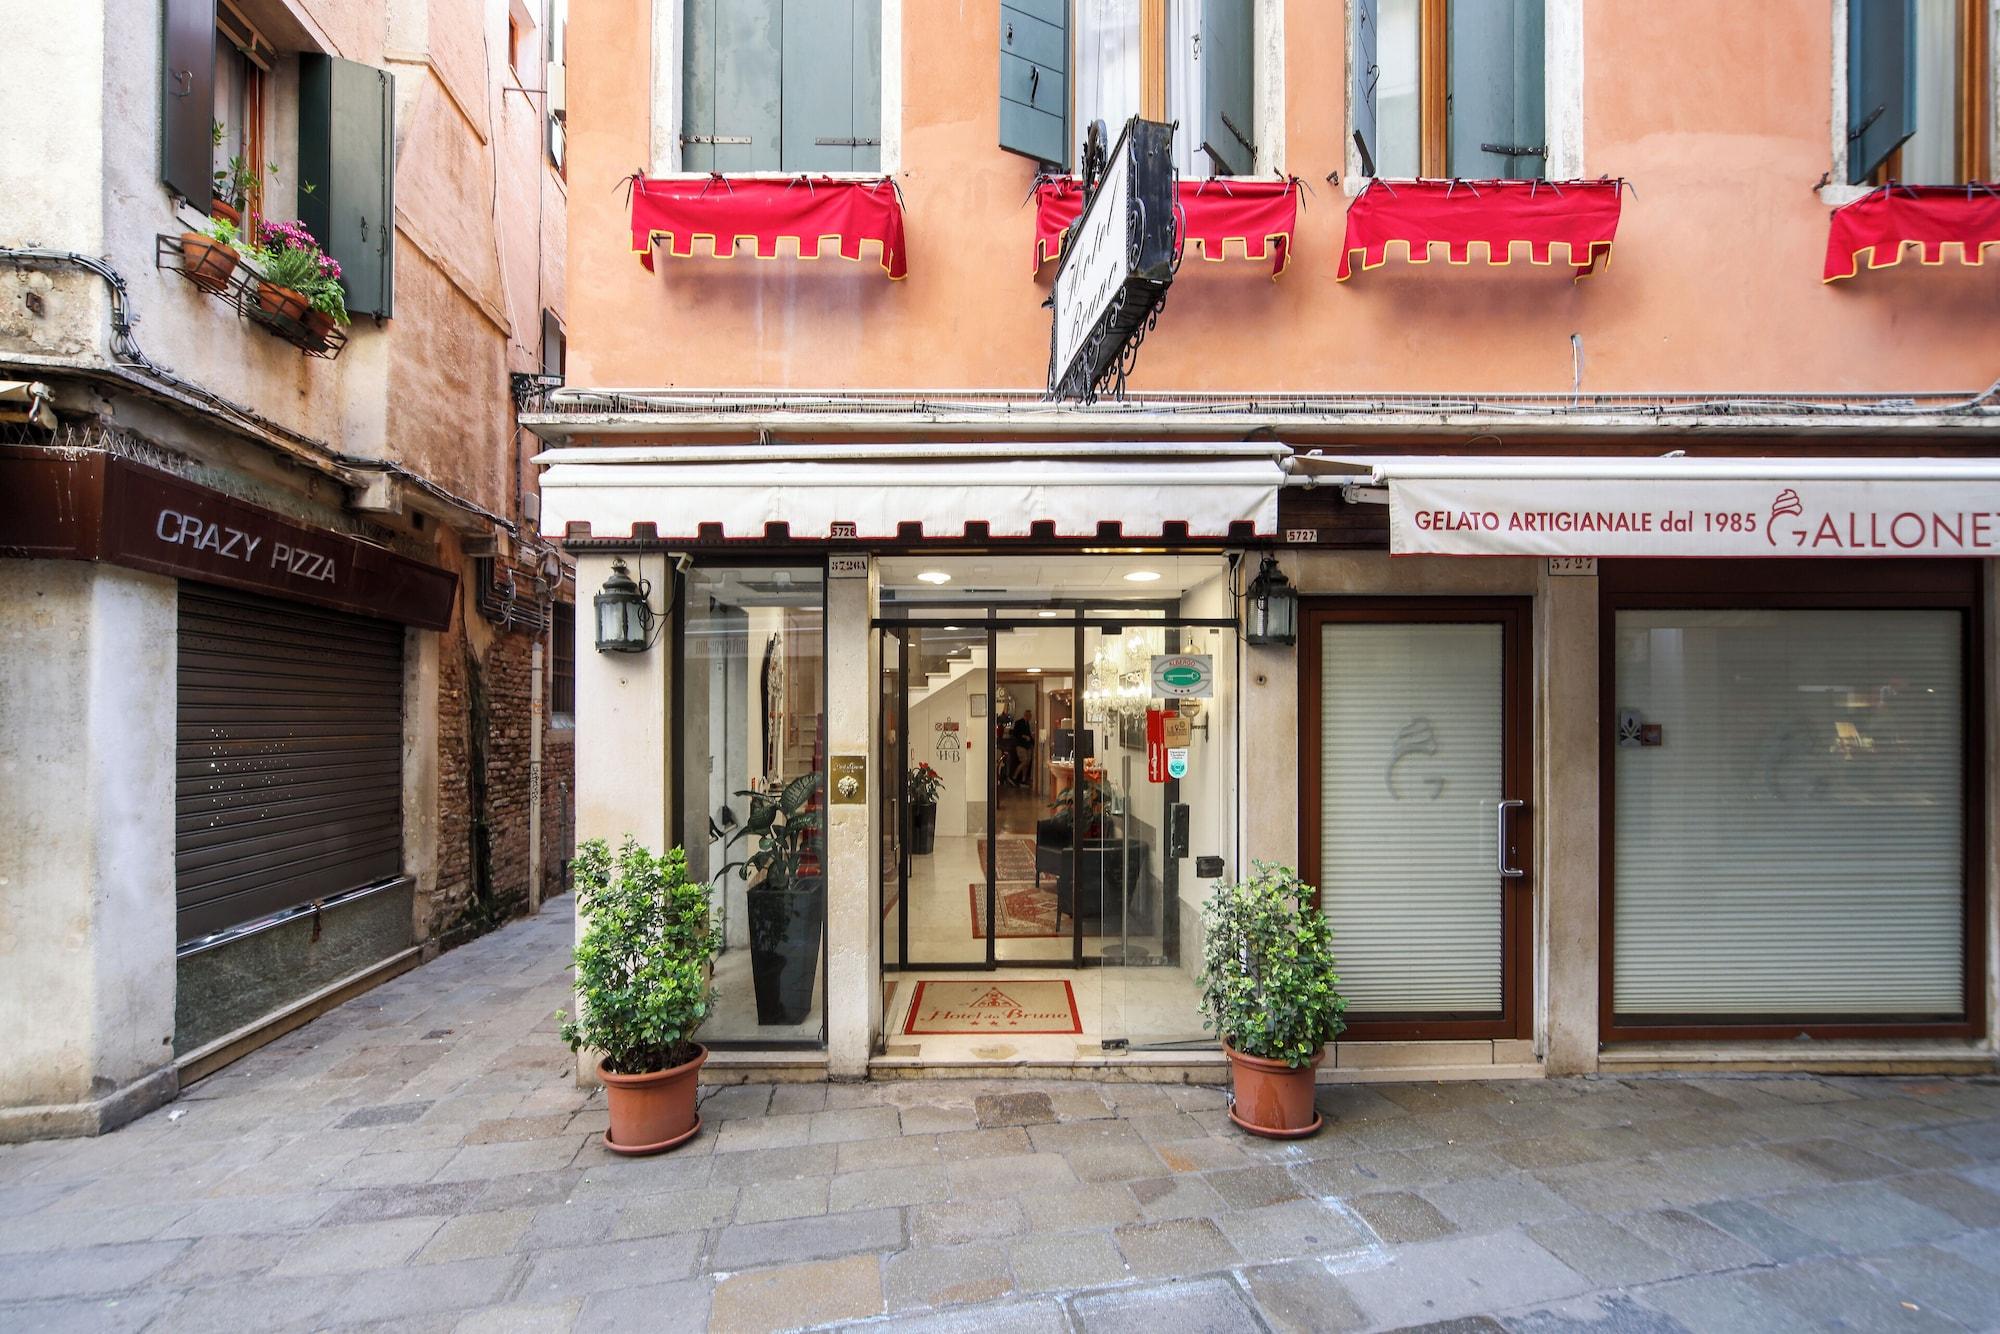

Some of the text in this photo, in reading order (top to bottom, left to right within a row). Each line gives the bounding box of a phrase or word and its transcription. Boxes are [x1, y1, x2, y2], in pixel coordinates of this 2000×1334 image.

[832, 527, 855, 537] 5726
[1415, 510, 2000, 549] GELATO ARTIGIANALE dal 1985 GALLONE
[1289, 531, 1314, 540] 5727
[156, 509, 336, 584] CRAZY PIZZA
[831, 561, 866, 570] 5726A
[1552, 558, 1593, 569] 5727
[920, 1010, 982, 1021] Hotel
[1002, 1008, 1067, 1019] Bruno
